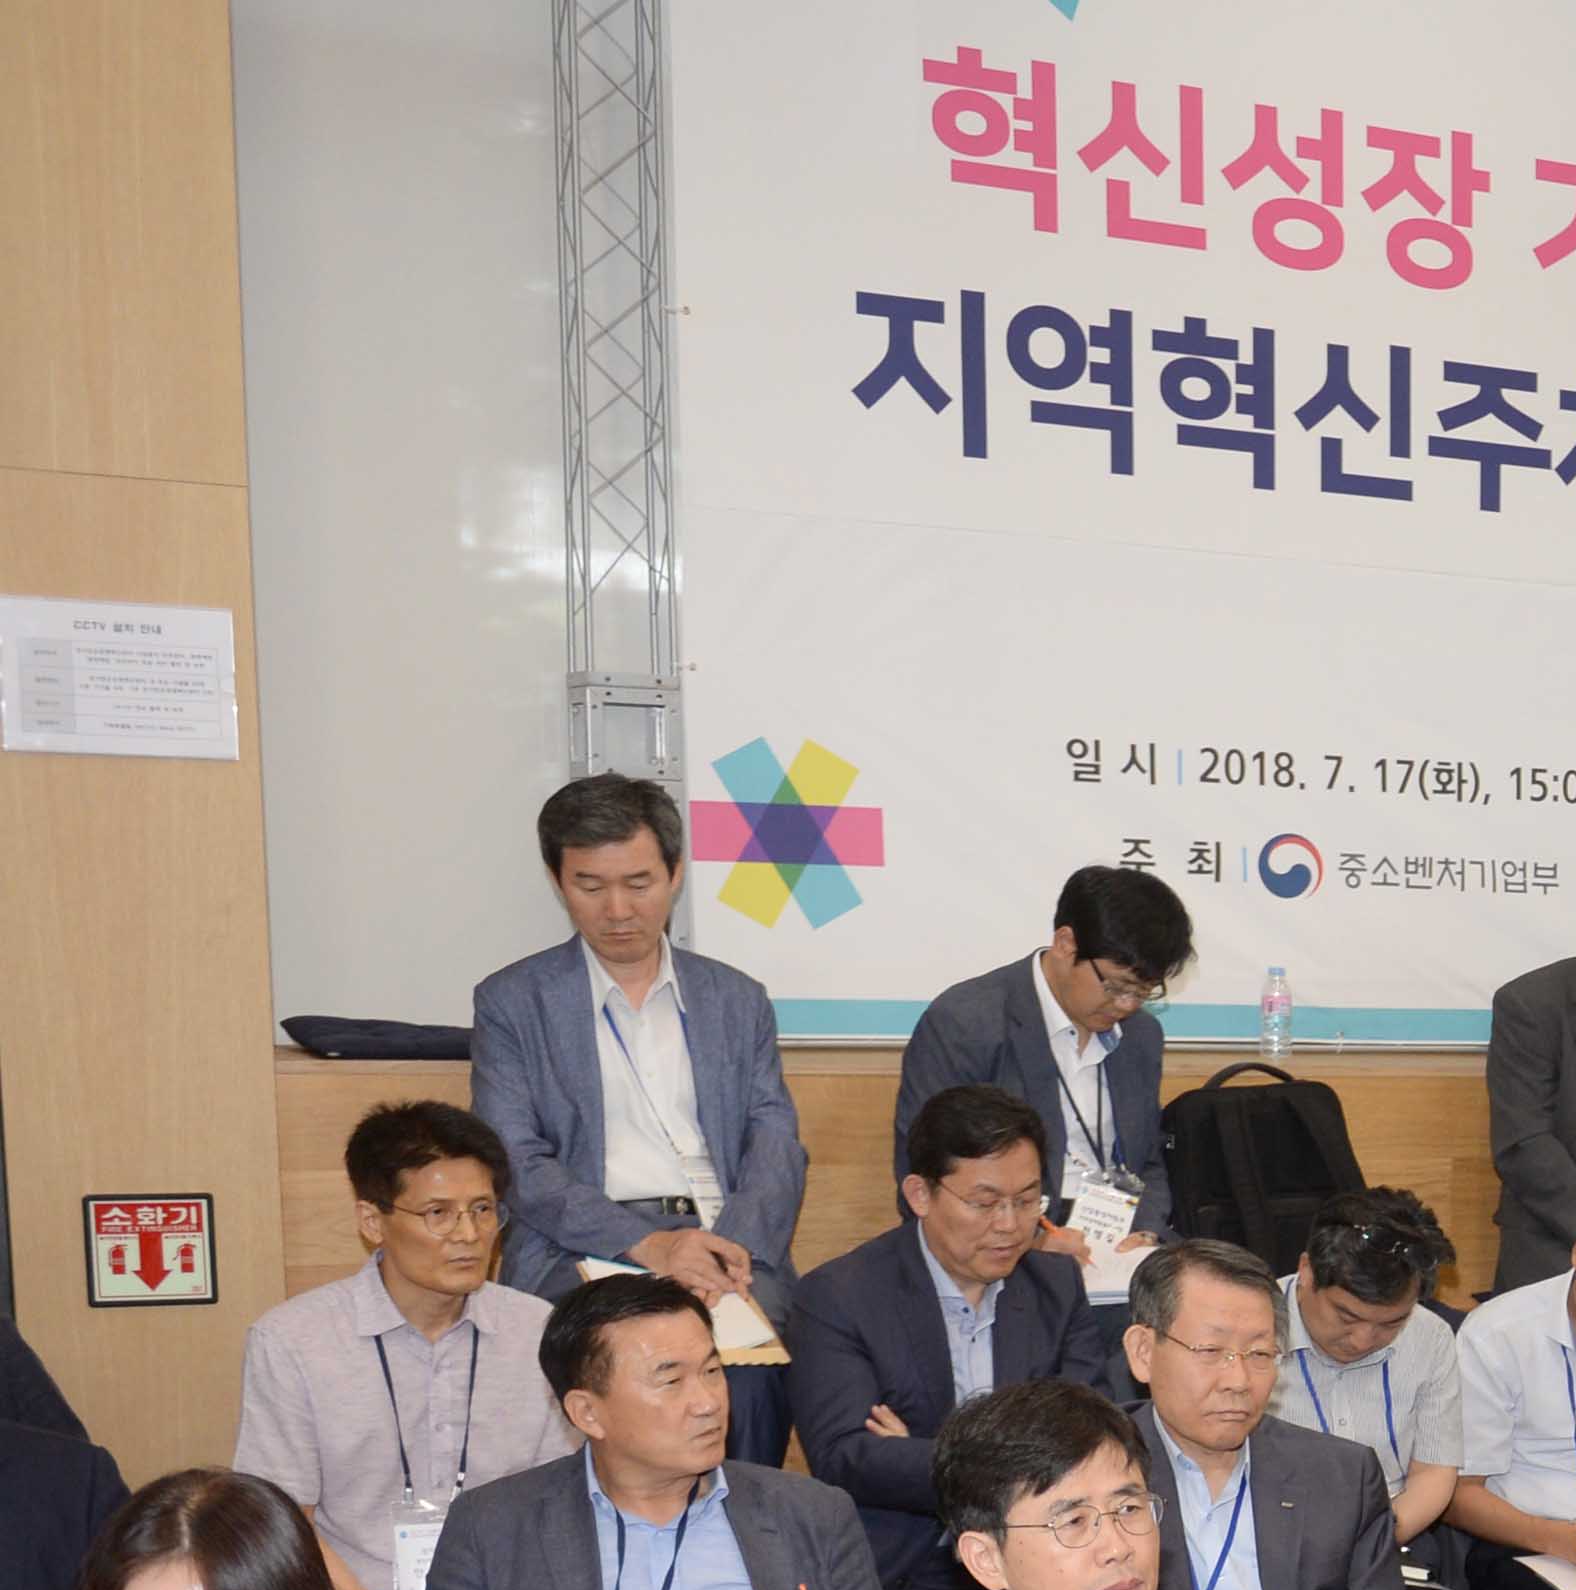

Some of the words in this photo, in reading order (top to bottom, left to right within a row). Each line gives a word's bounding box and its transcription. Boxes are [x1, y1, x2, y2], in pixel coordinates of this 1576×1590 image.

[922, 46, 1491, 291] 혁신성장
[1199, 747, 1306, 790] 2018.
[1323, 755, 1355, 793] 7.
[1374, 758, 1491, 805] 17(화),
[1338, 852, 1560, 896] 중소벤처기업부
[101, 1205, 198, 1226] 소화기
